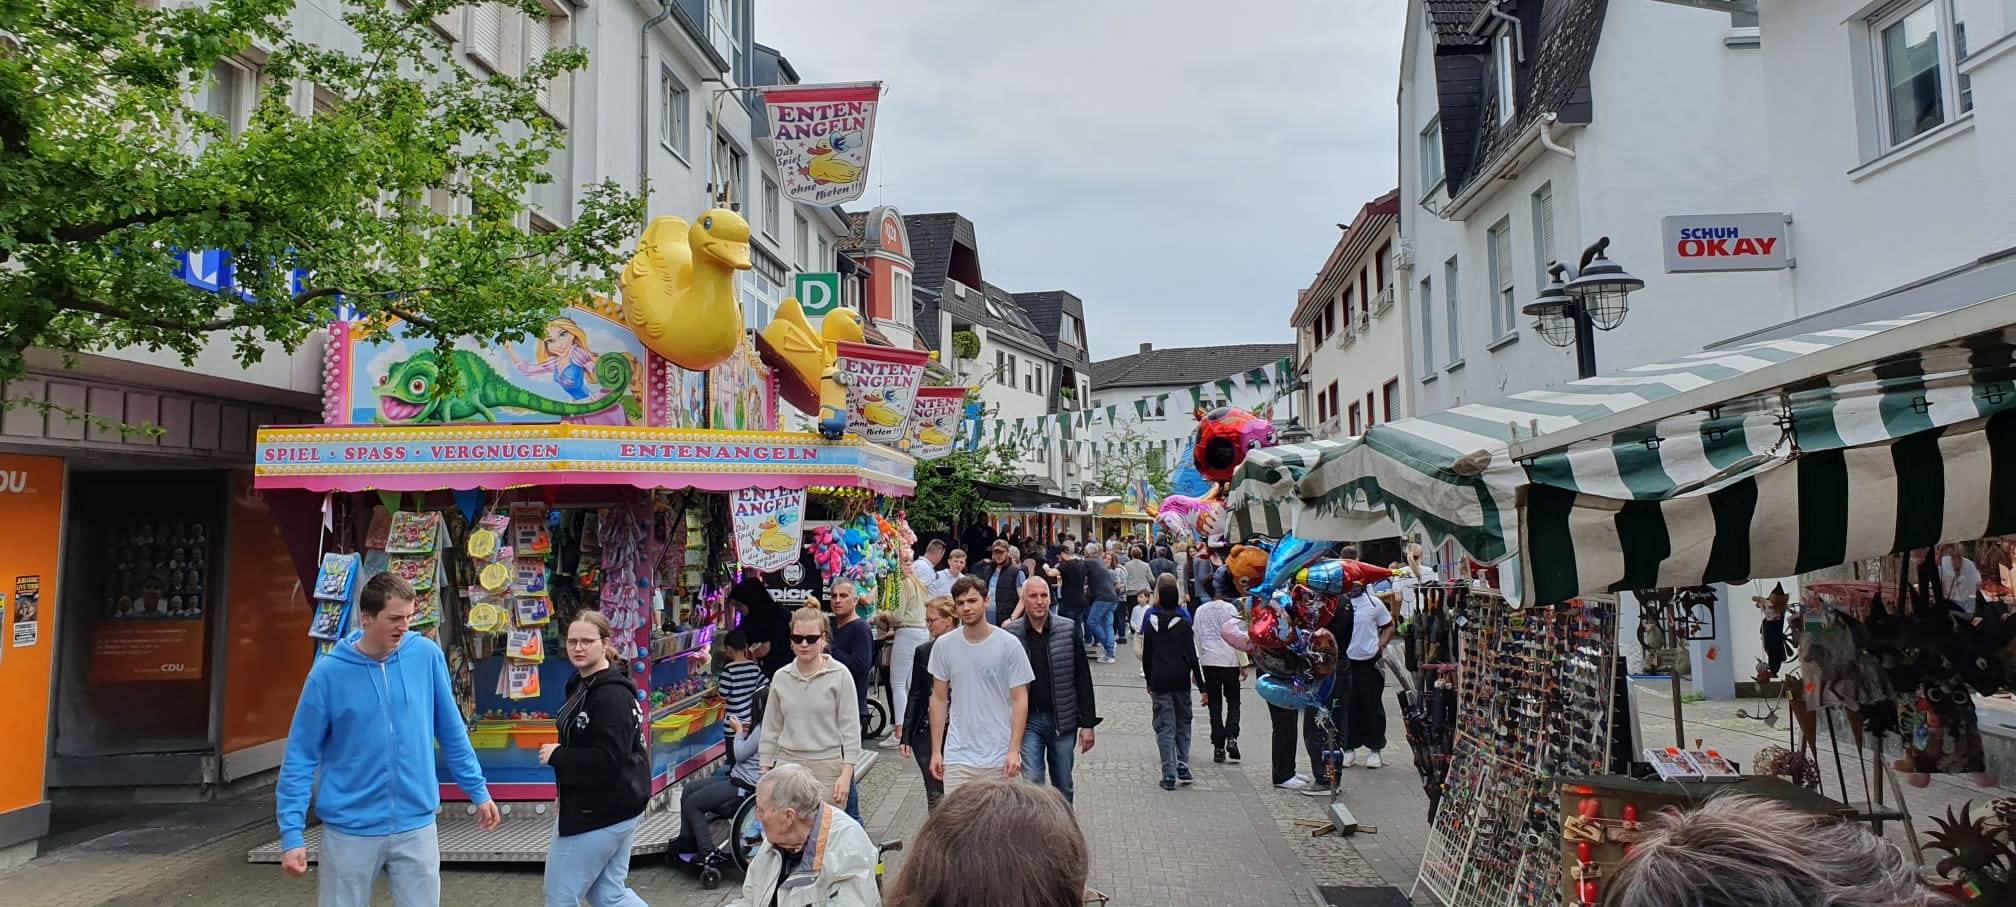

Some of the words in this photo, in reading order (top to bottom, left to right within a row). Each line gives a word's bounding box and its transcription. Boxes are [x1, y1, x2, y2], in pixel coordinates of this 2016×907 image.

[777, 101, 868, 122] ENTEN-
[775, 117, 866, 140] ANGELN
[776, 148, 793, 157] Das
[777, 154, 801, 167] Spiel
[791, 184, 816, 195] ohne
[1681, 227, 1738, 239] SCHUH
[1677, 237, 1776, 257] OKAY
[802, 280, 831, 309] D
[845, 361, 916, 376] ENTEN-
[856, 375, 913, 387] NGELN
[915, 398, 958, 408] NTEN-
[913, 407, 956, 418] NGELN
[264, 447, 321, 461] SPIEL
[344, 446, 406, 460] SPASS
[431, 443, 560, 458] VERGNÜGEN
[620, 444, 818, 460] ENTENANGELN
[736, 495, 800, 516] ANGELN
[160, 663, 184, 671] CDU
